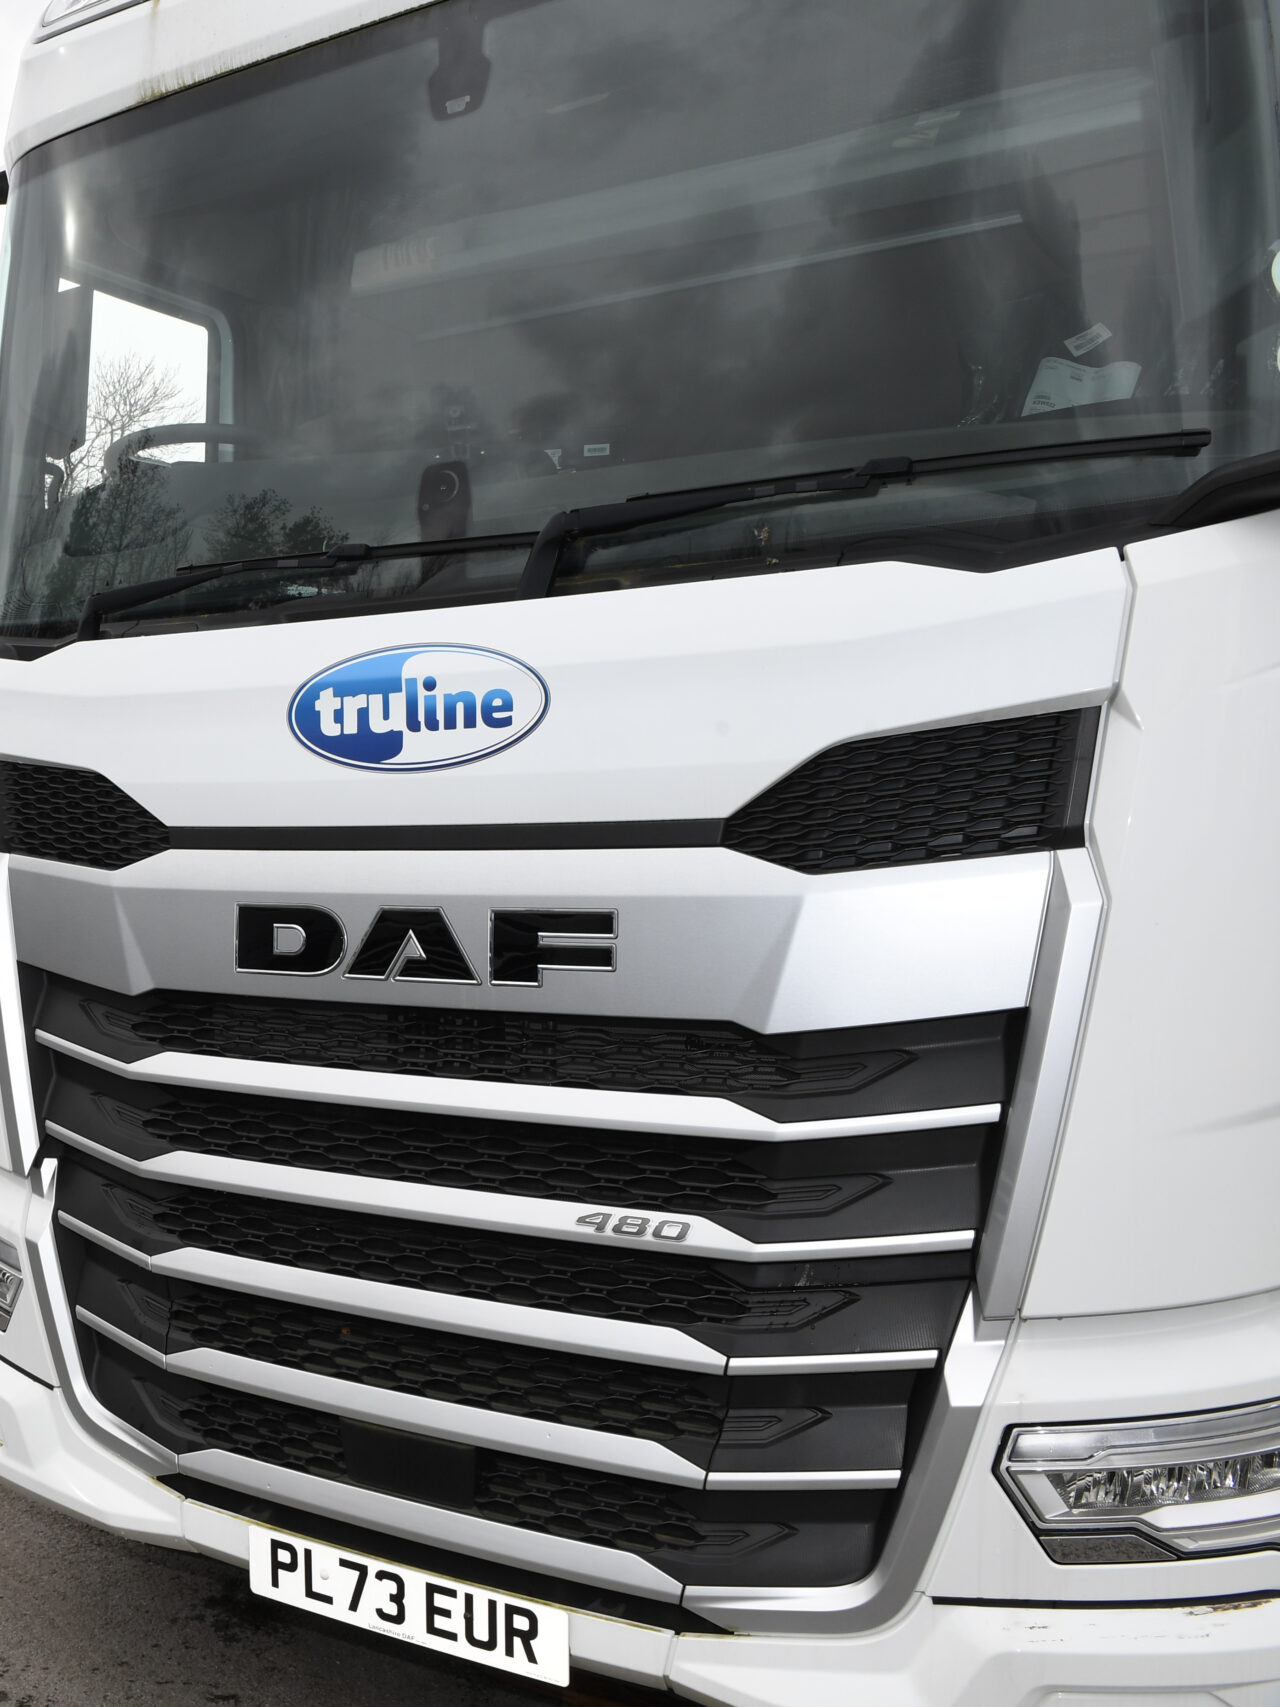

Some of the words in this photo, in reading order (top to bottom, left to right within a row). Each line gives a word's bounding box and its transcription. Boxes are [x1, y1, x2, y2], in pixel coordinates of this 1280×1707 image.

[315, 676, 514, 737] truline
[234, 902, 619, 988] DAF
[575, 1212, 692, 1243] 480
[269, 1537, 407, 1626] PL73
[425, 1581, 539, 1665] EUR
